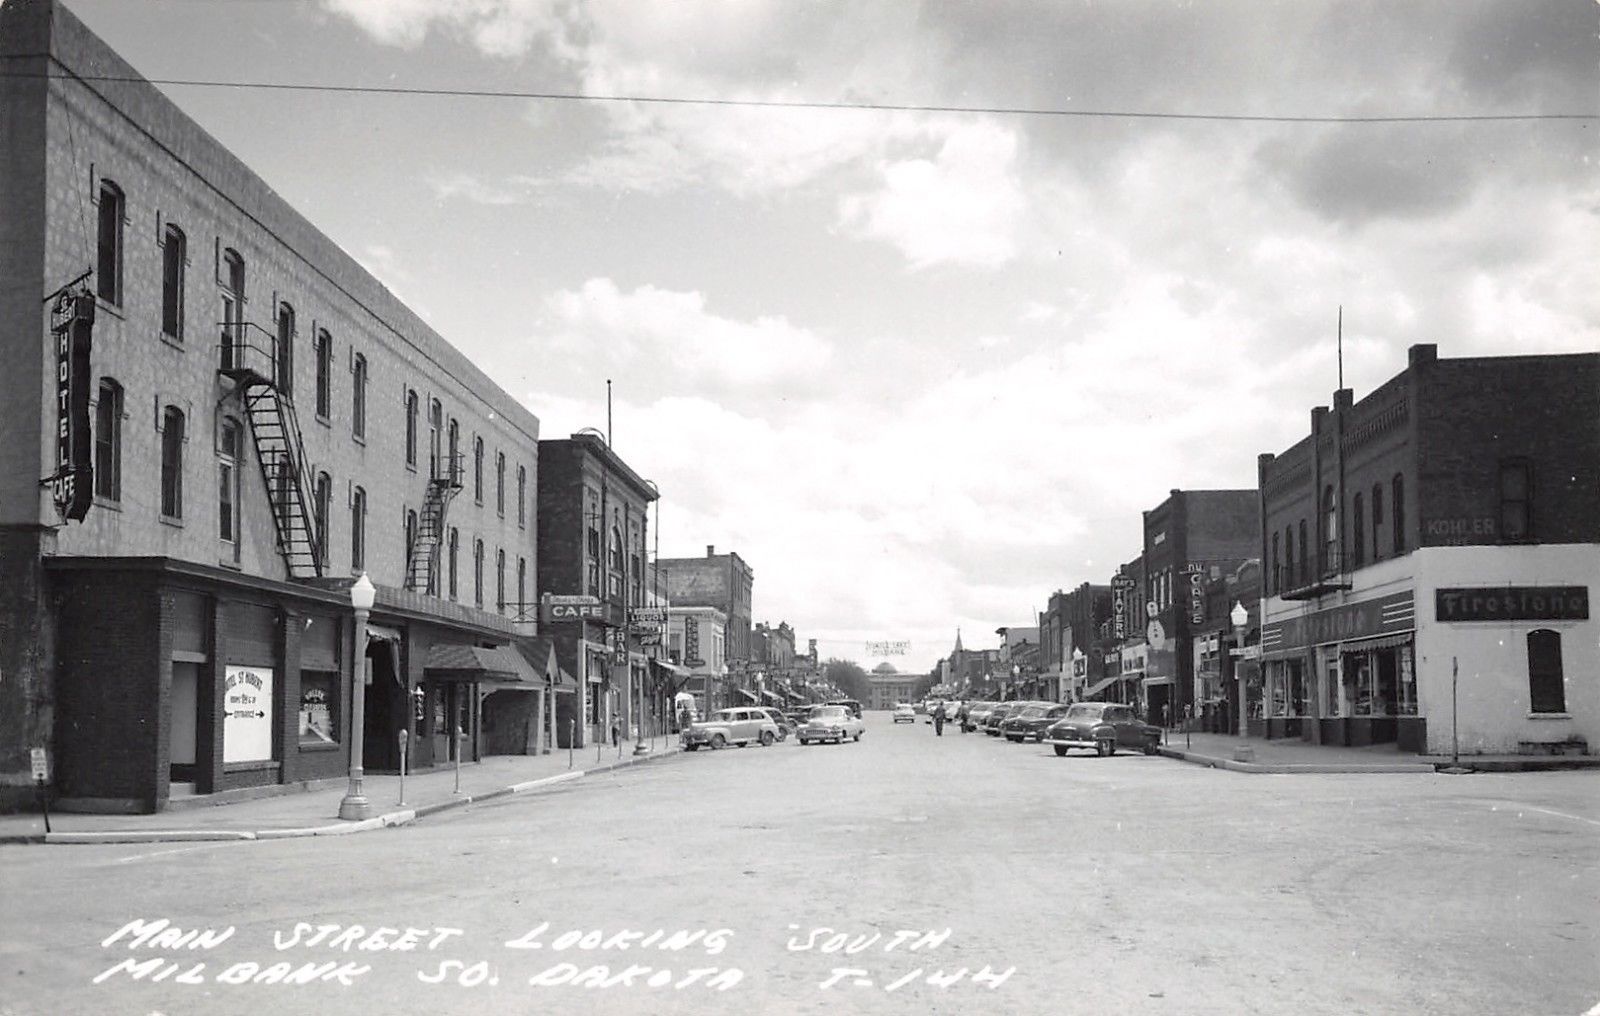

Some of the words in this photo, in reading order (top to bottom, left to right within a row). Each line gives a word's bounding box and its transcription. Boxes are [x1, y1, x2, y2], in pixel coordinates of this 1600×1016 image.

[60, 332, 68, 466] HOTEL
[55, 475, 75, 502] CAFE
[1427, 518, 1495, 535] KOHLER
[552, 606, 603, 617] CAFE
[1190, 574, 1203, 624] CAFE
[1441, 593, 1583, 615] Firestone
[631, 613, 665, 621] LIQUOR
[1115, 588, 1124, 639] TAVERN
[616, 631, 625, 662] BAR
